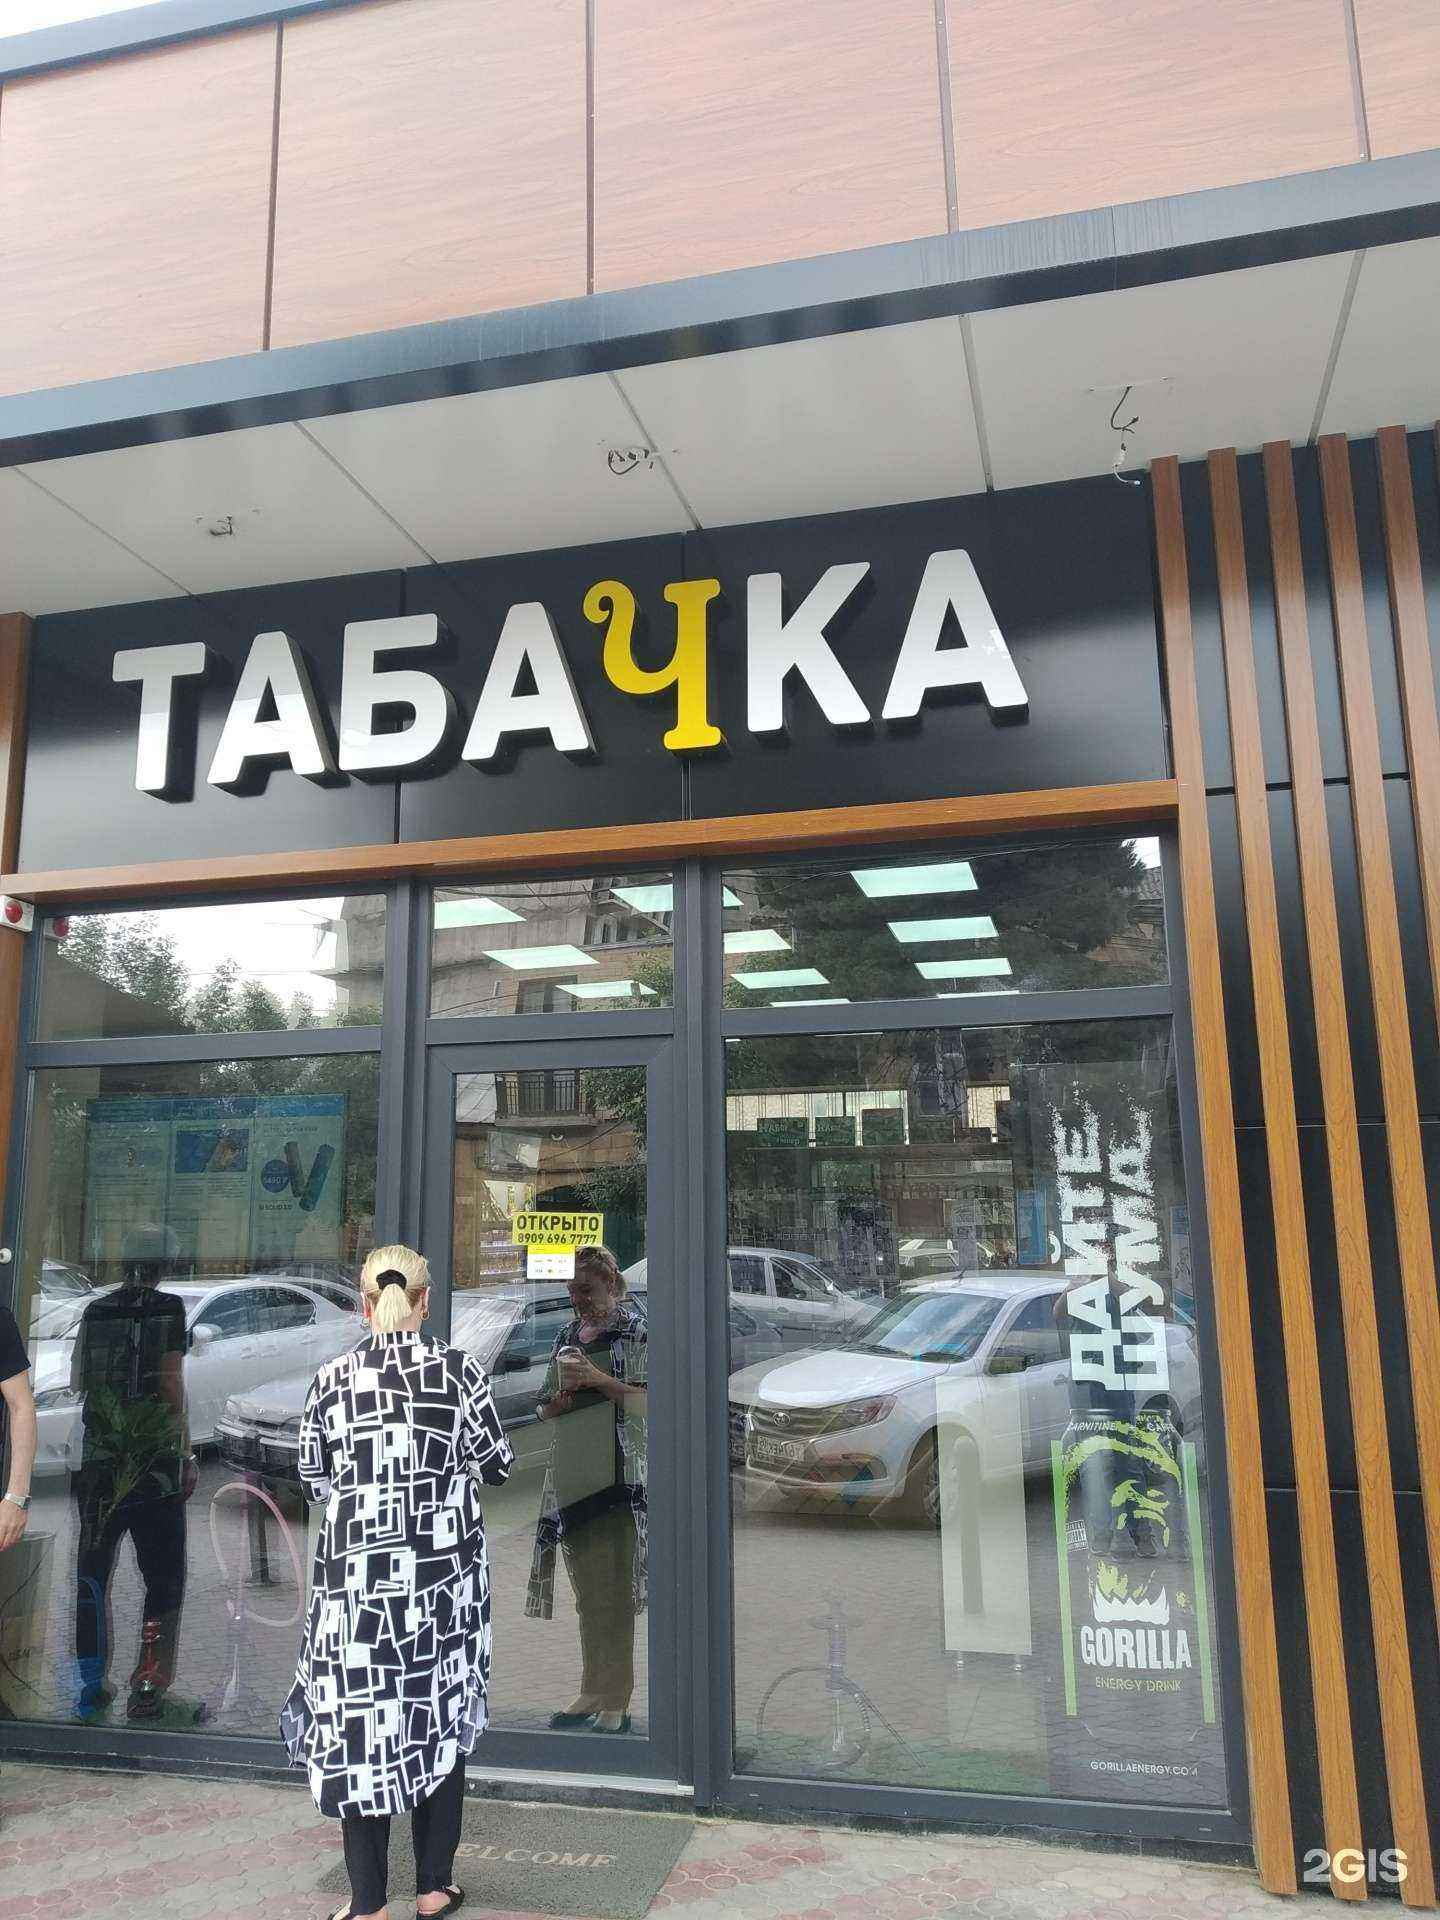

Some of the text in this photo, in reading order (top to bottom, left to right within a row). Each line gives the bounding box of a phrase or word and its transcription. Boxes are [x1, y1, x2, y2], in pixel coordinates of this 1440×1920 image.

[113, 549, 1029, 796] ТАБАЧКА
[517, 1215, 599, 1231] ОТКРЫТО
[518, 1233, 597, 1245] 8909 696 7777
[1048, 1094, 1125, 1389] ДАЙТЕ
[1108, 1104, 1169, 1389] ШУМА
[1080, 1626, 1192, 1669] GORILLA
[1095, 1676, 1184, 1692] ENERGY DRINK
[454, 1843, 617, 1868] ELCOME
